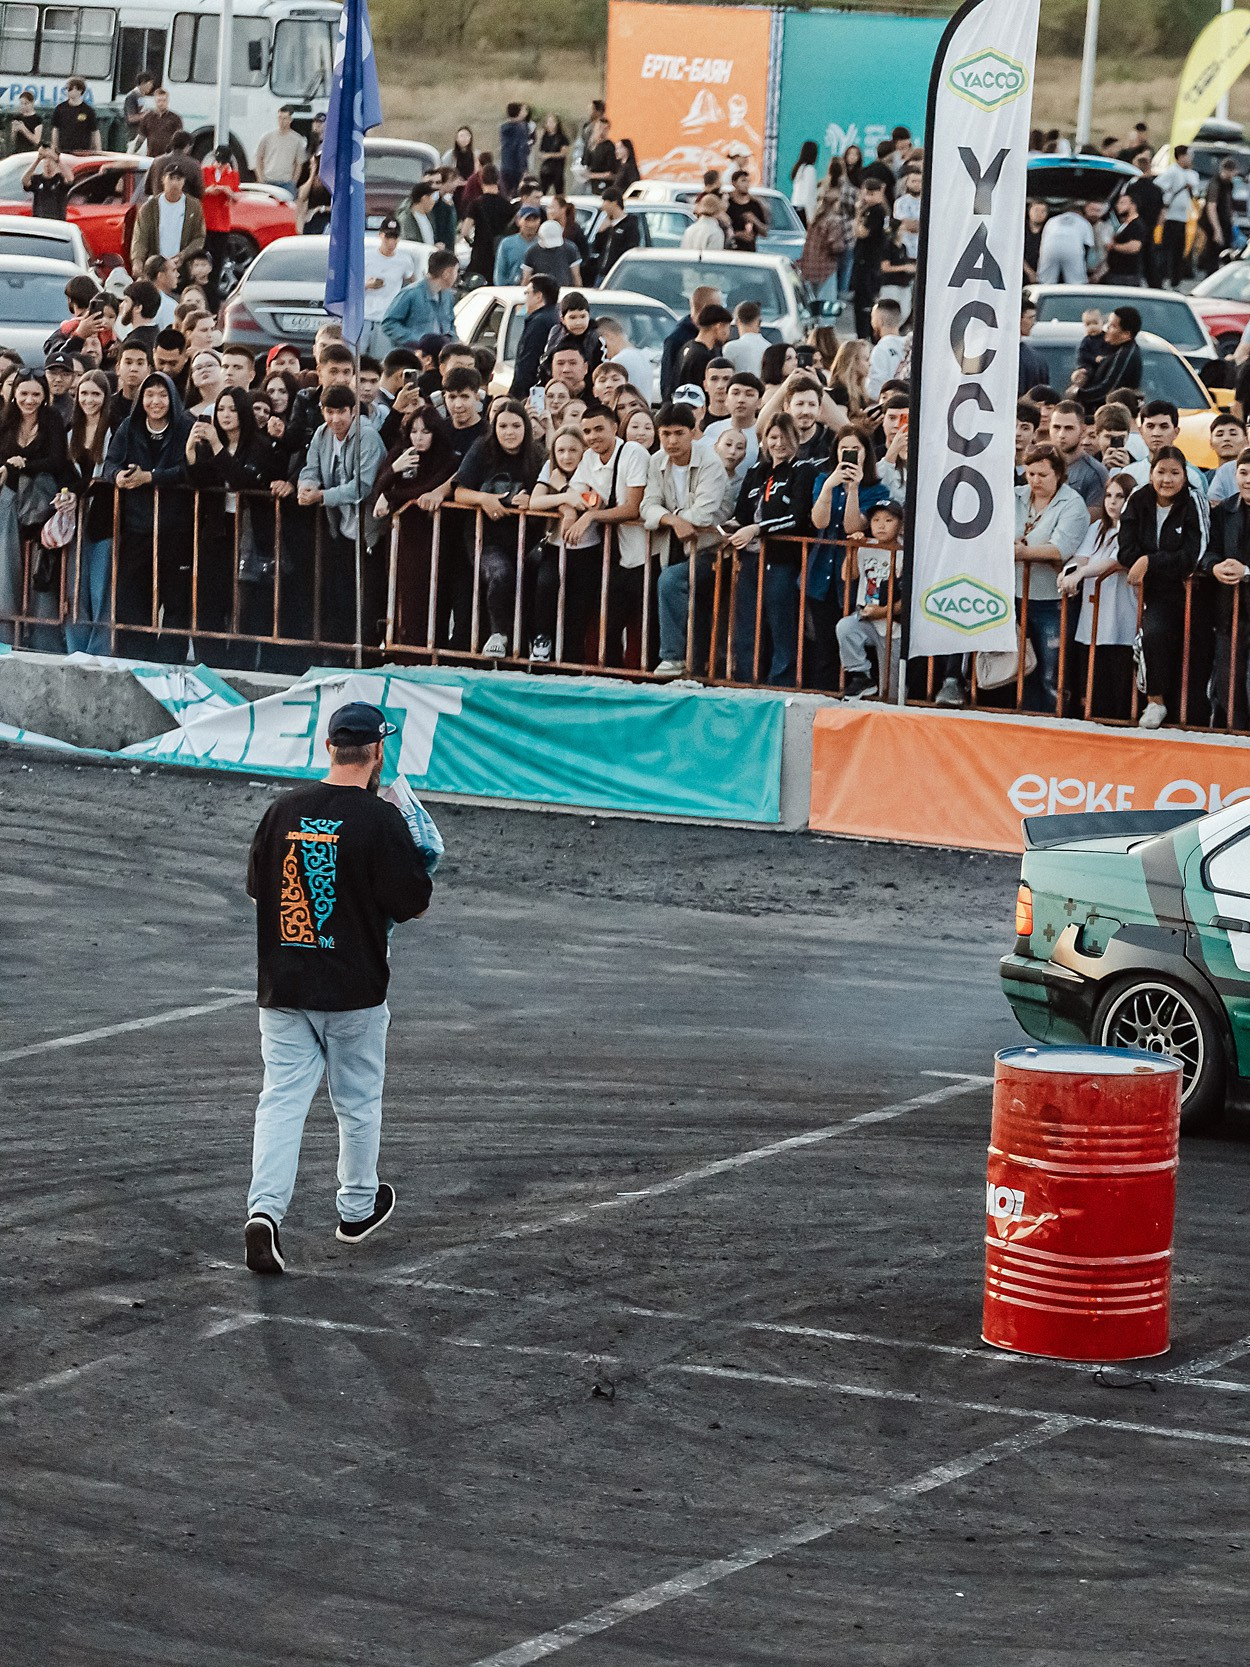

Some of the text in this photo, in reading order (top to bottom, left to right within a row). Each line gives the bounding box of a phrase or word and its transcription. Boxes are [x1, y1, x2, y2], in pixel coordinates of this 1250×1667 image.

[960, 71, 1020, 89] YACCO
[937, 146, 1011, 539] YACCO
[932, 596, 1000, 616] YACCO
